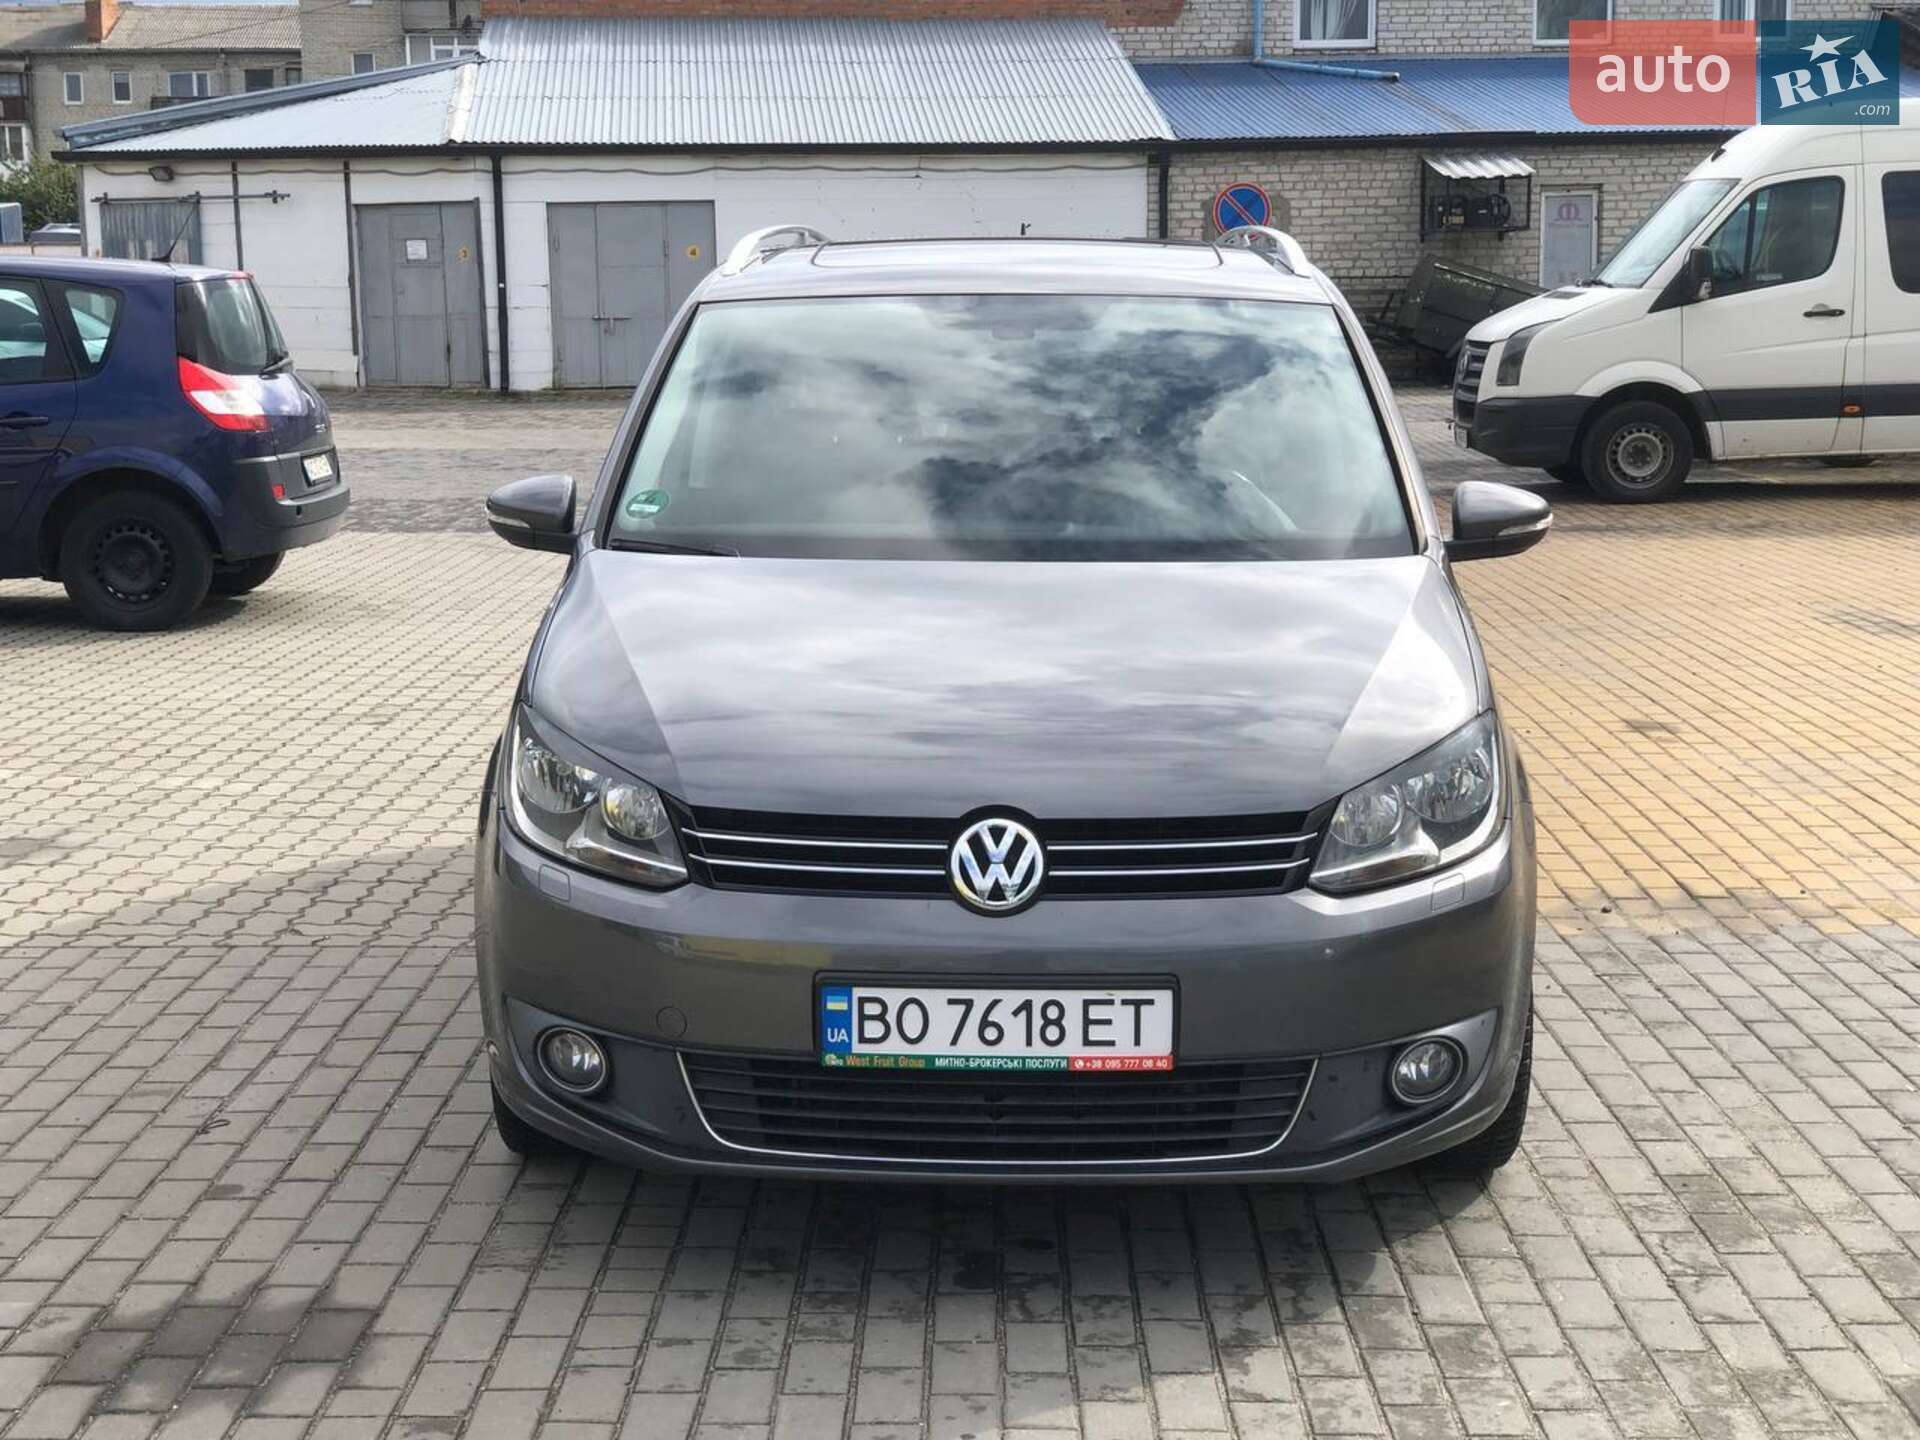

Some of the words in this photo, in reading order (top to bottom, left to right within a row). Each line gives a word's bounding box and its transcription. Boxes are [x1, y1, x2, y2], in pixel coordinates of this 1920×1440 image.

[857, 996, 930, 1045] BO
[947, 998, 1066, 1048] 7618
[1082, 998, 1155, 1048] ET
[827, 1028, 849, 1043] UA
[846, 1055, 870, 1066] West
[873, 1056, 894, 1067] Fruit
[899, 1056, 926, 1068] Group
[935, 1057, 1023, 1069] МИТНО-БРОКЕРСЬКІ
[1025, 1058, 1068, 1069] ПОСЛУГИ
[1123, 1059, 1140, 1069] 777
